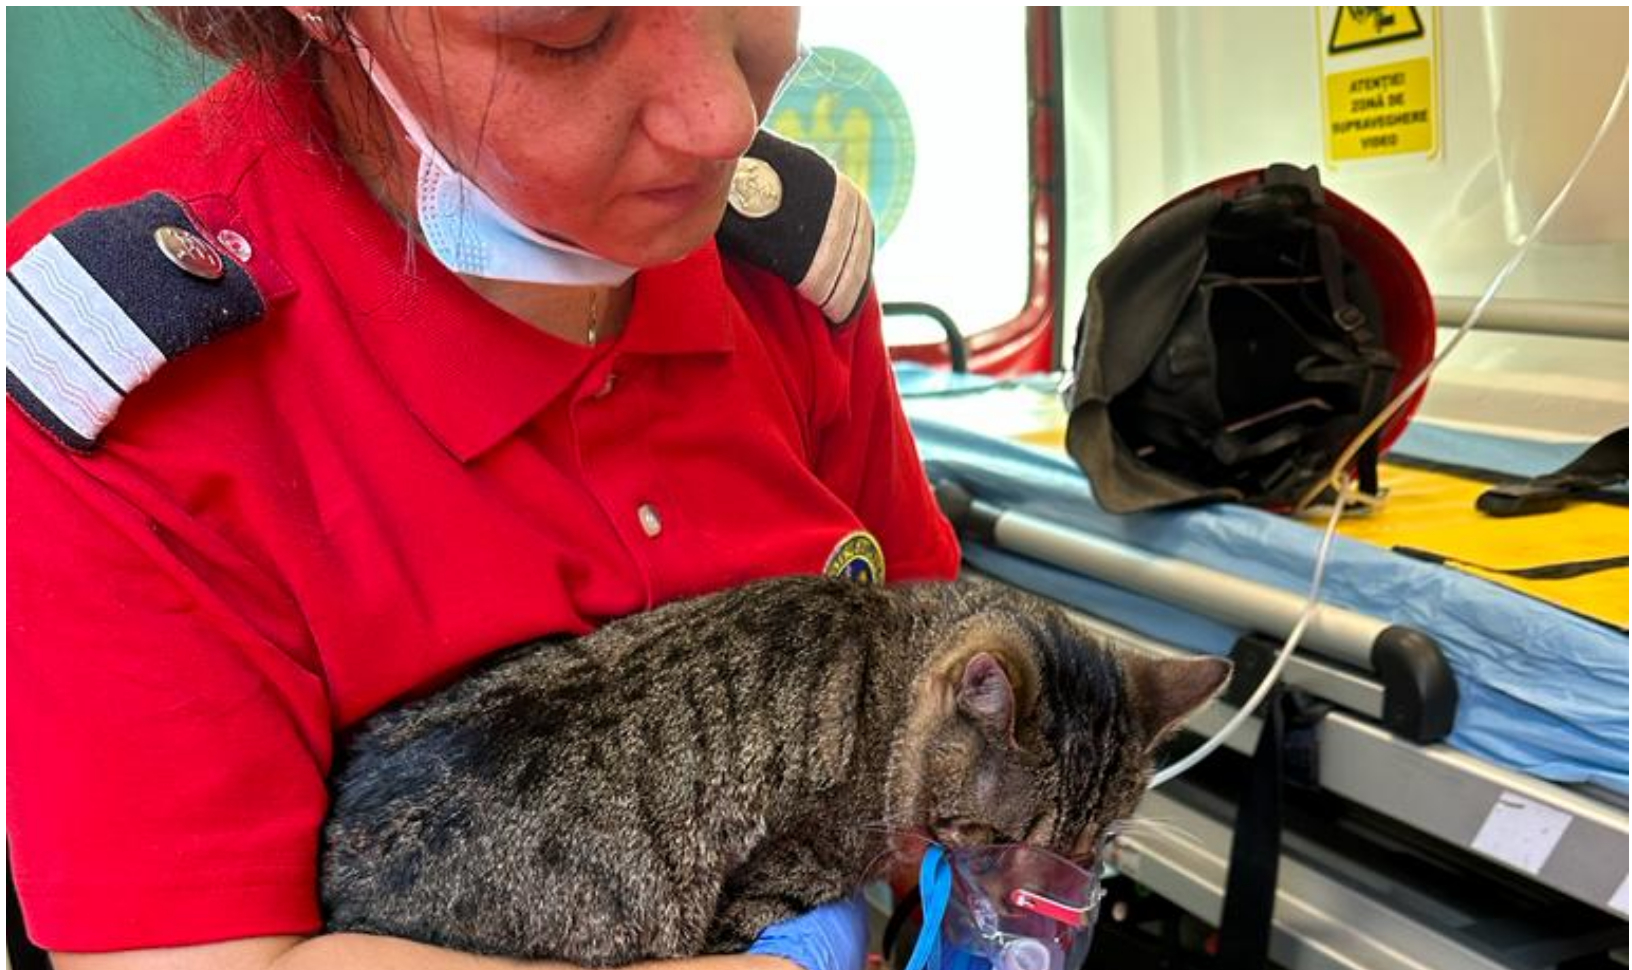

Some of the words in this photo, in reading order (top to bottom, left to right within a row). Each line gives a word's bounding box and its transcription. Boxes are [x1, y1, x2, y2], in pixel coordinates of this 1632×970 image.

[1389, 93, 1404, 107] DE
[1332, 109, 1427, 133] SUPRAVEGHERE
[1361, 133, 1398, 149] VIDEO
